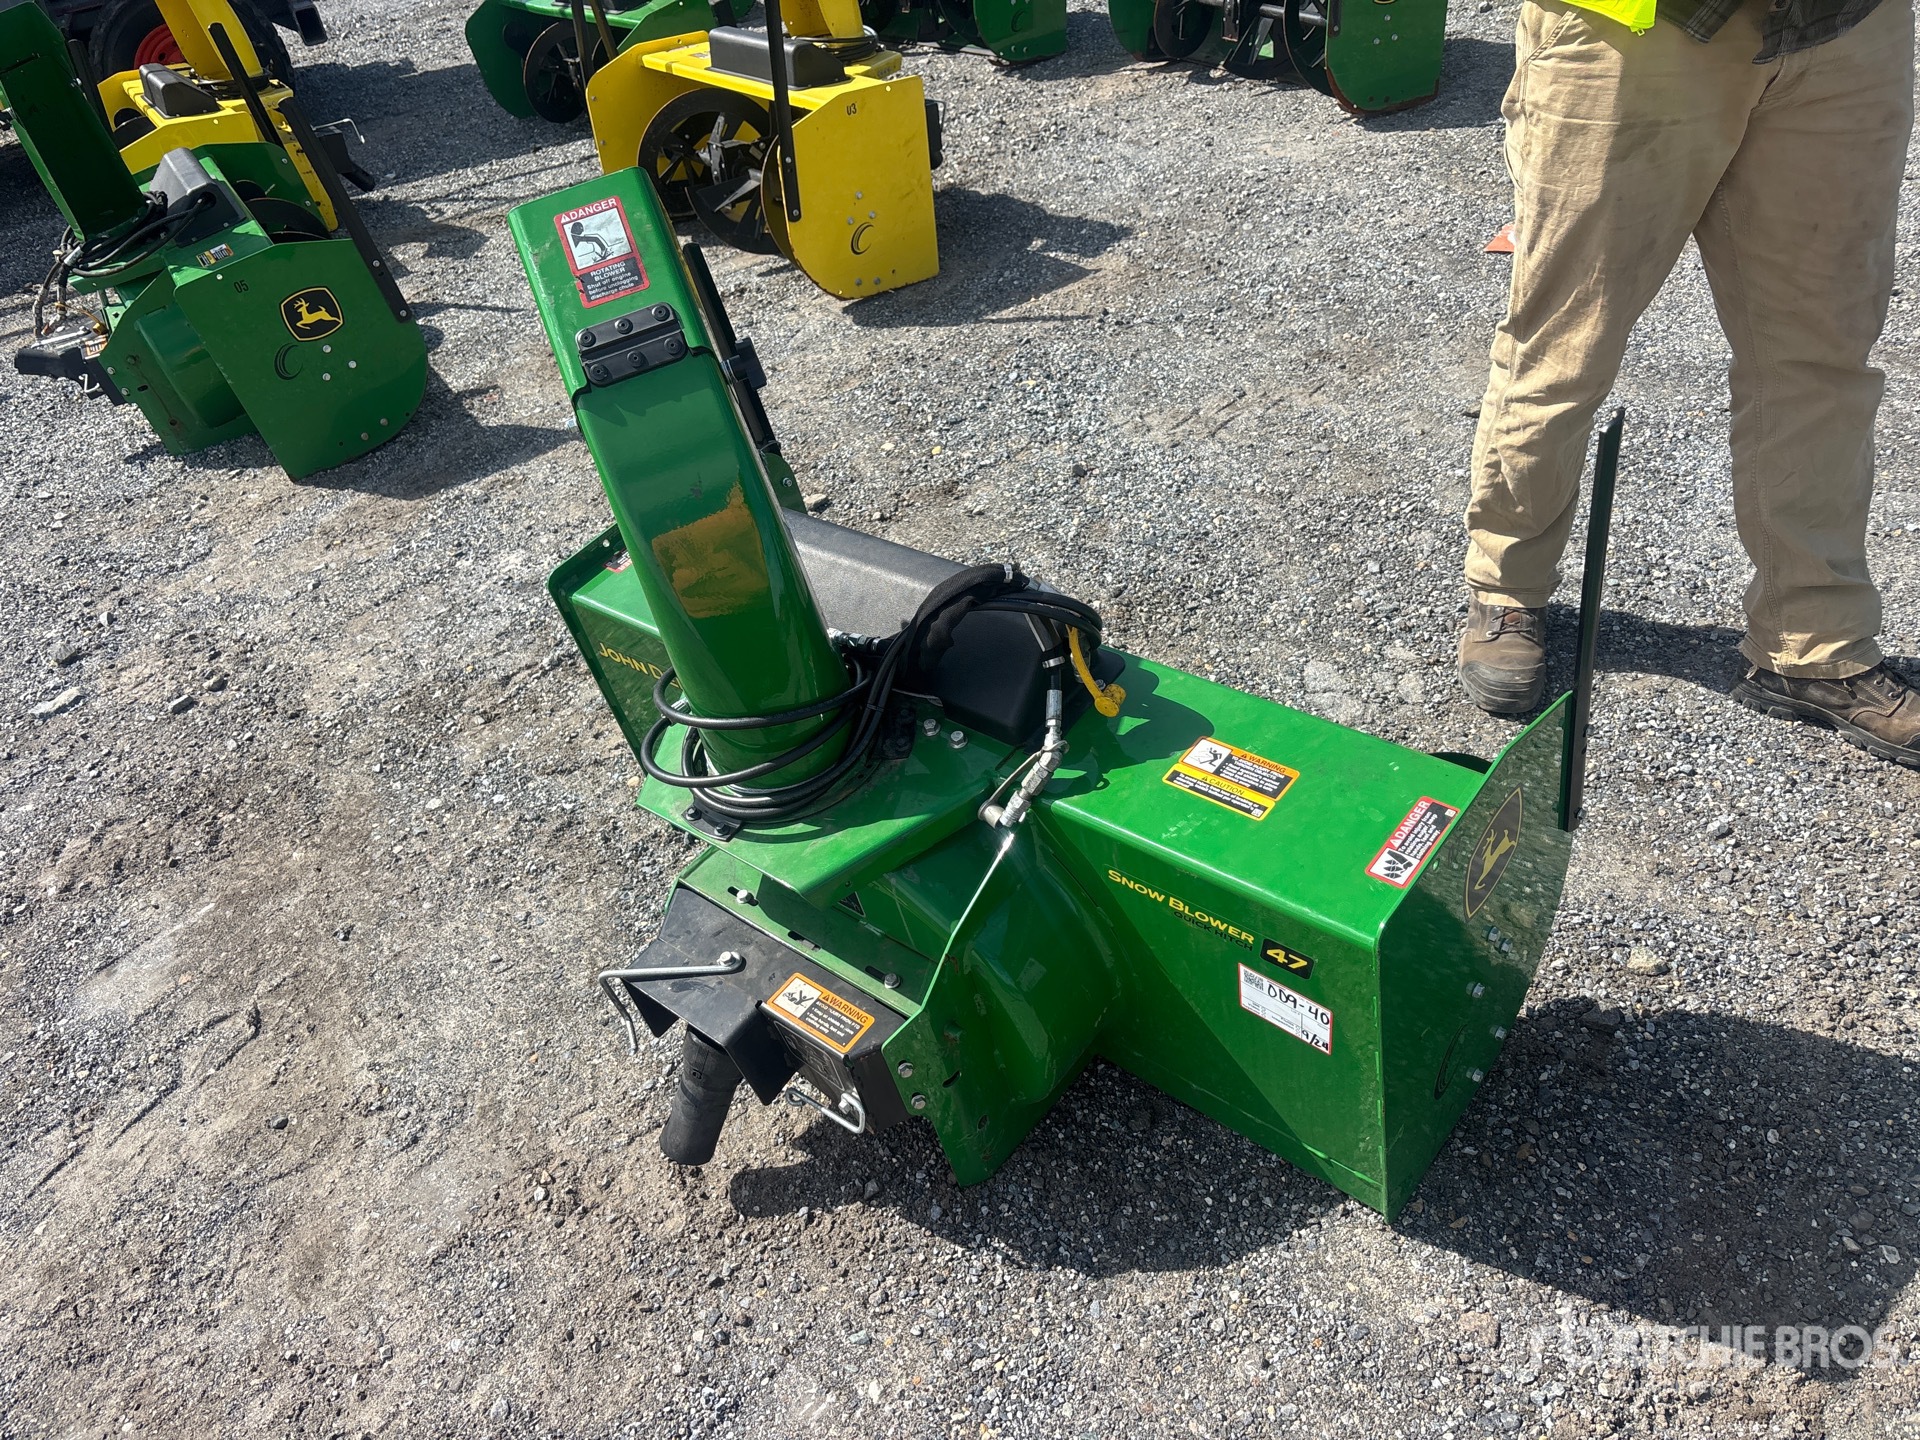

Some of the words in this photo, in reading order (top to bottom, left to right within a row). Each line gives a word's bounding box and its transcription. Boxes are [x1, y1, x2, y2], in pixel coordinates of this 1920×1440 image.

[569, 198, 617, 220] DANGER
[590, 261, 626, 277] ROTATING
[594, 268, 626, 281] BLOWER
[587, 281, 601, 290] Shut
[611, 271, 632, 283] engine
[600, 642, 648, 675] JOHN
[1249, 755, 1287, 774] WARNING
[1209, 778, 1245, 796] CAUTION
[1394, 800, 1431, 839] DANGER
[1108, 869, 1165, 902] SNOW
[1168, 896, 1255, 945] BLOWER
[1173, 911, 1212, 933] QUICK
[1214, 929, 1253, 952] HITCH
[1266, 948, 1308, 970] 47
[829, 996, 869, 1024] WARNING
